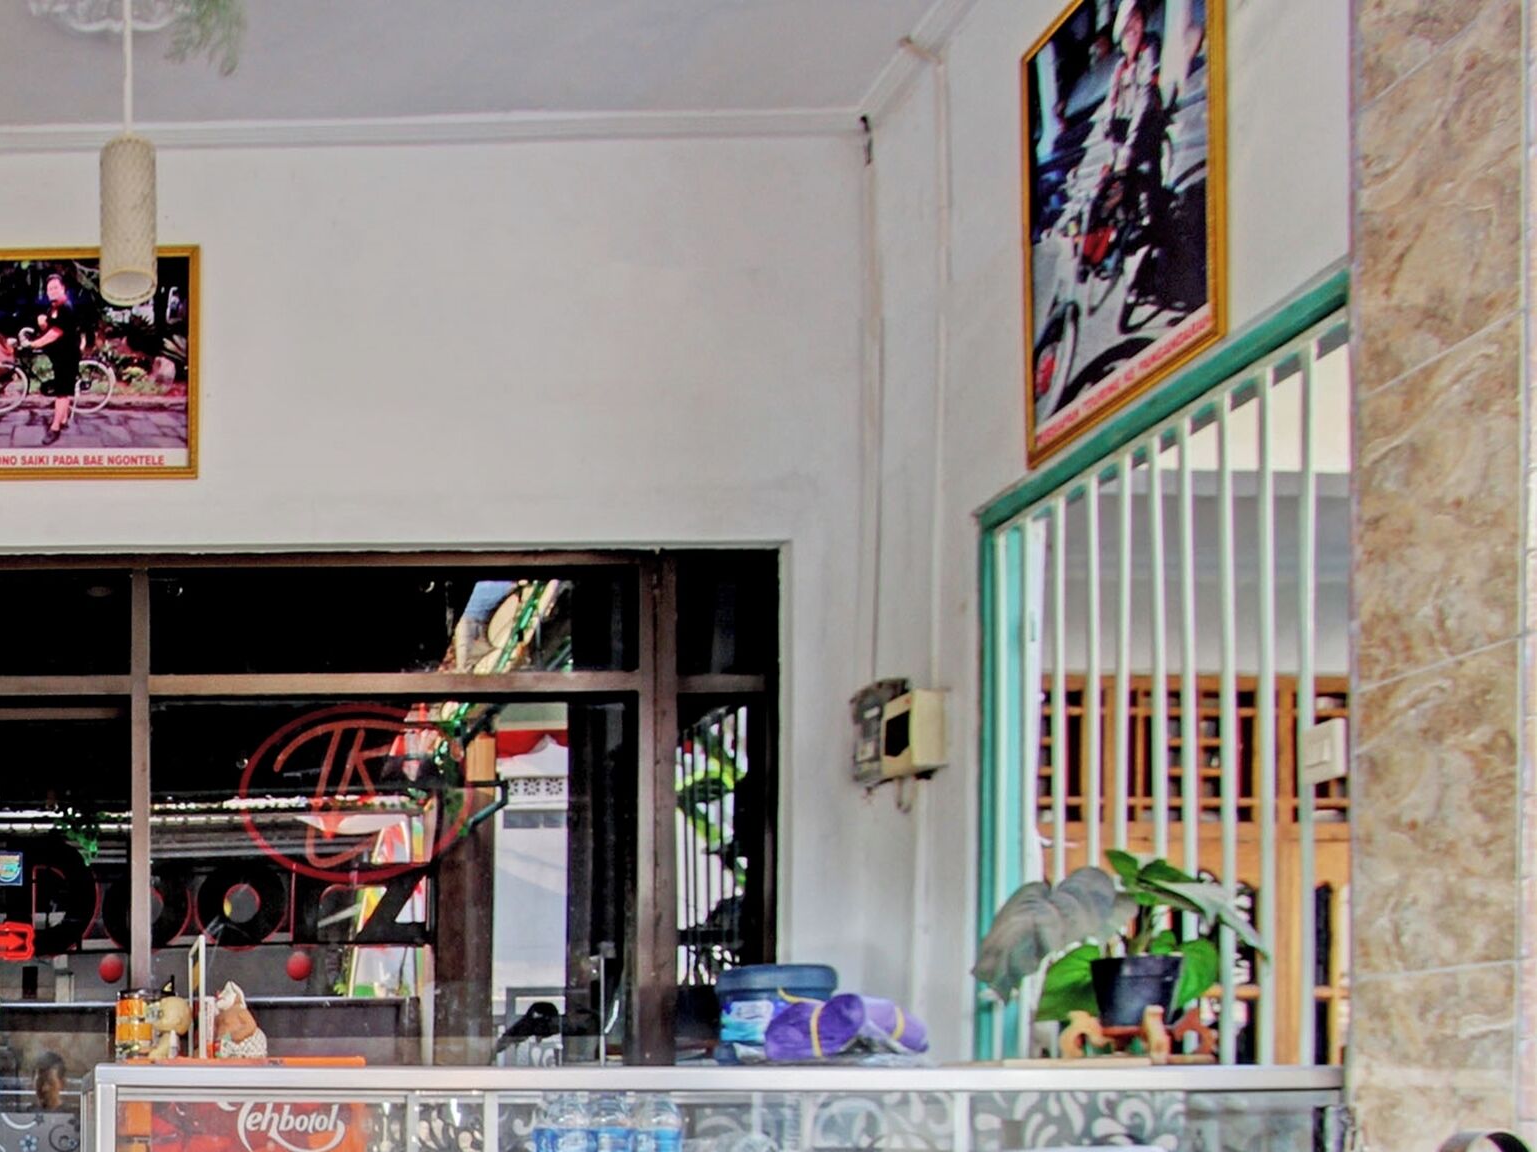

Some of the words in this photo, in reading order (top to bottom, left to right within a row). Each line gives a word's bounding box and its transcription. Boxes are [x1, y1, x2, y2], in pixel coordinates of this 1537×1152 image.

[20, 455, 50, 466] SAIKI
[53, 454, 80, 466] PADA
[83, 454, 104, 466] BAE
[107, 454, 165, 466] NGONTELE
